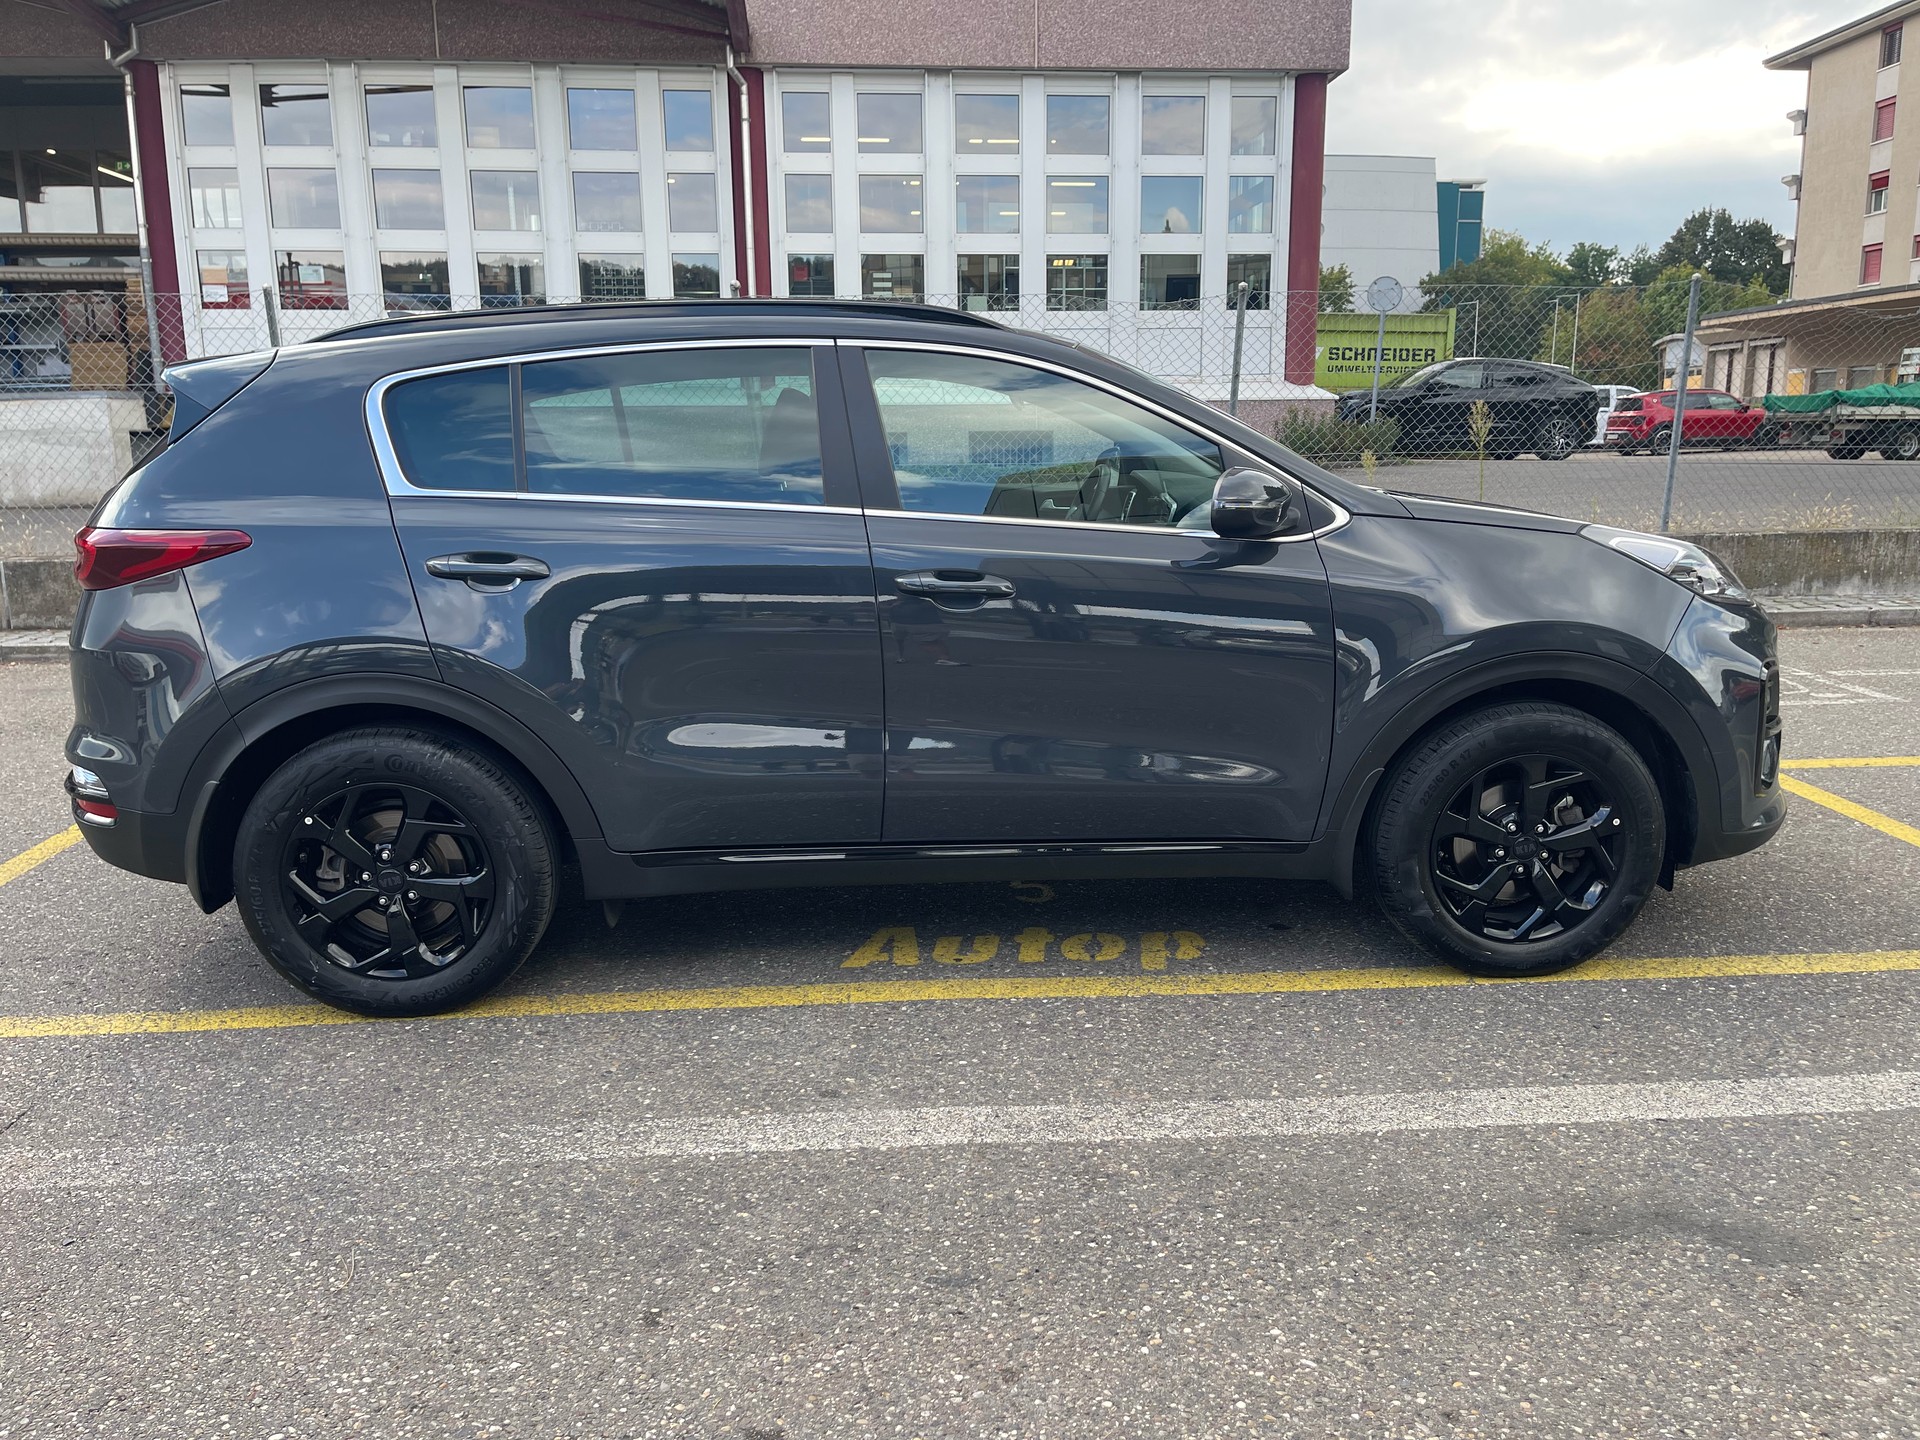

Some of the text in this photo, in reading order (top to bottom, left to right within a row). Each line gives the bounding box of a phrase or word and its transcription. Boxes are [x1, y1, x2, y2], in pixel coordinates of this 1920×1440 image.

[1328, 346, 1436, 362] SCHNEIDER
[1419, 768, 1450, 807] 225/60
[1449, 759, 1460, 770] R
[1515, 843, 1537, 855] KIA
[378, 875, 402, 888] KIA
[839, 925, 1207, 970] Autop
